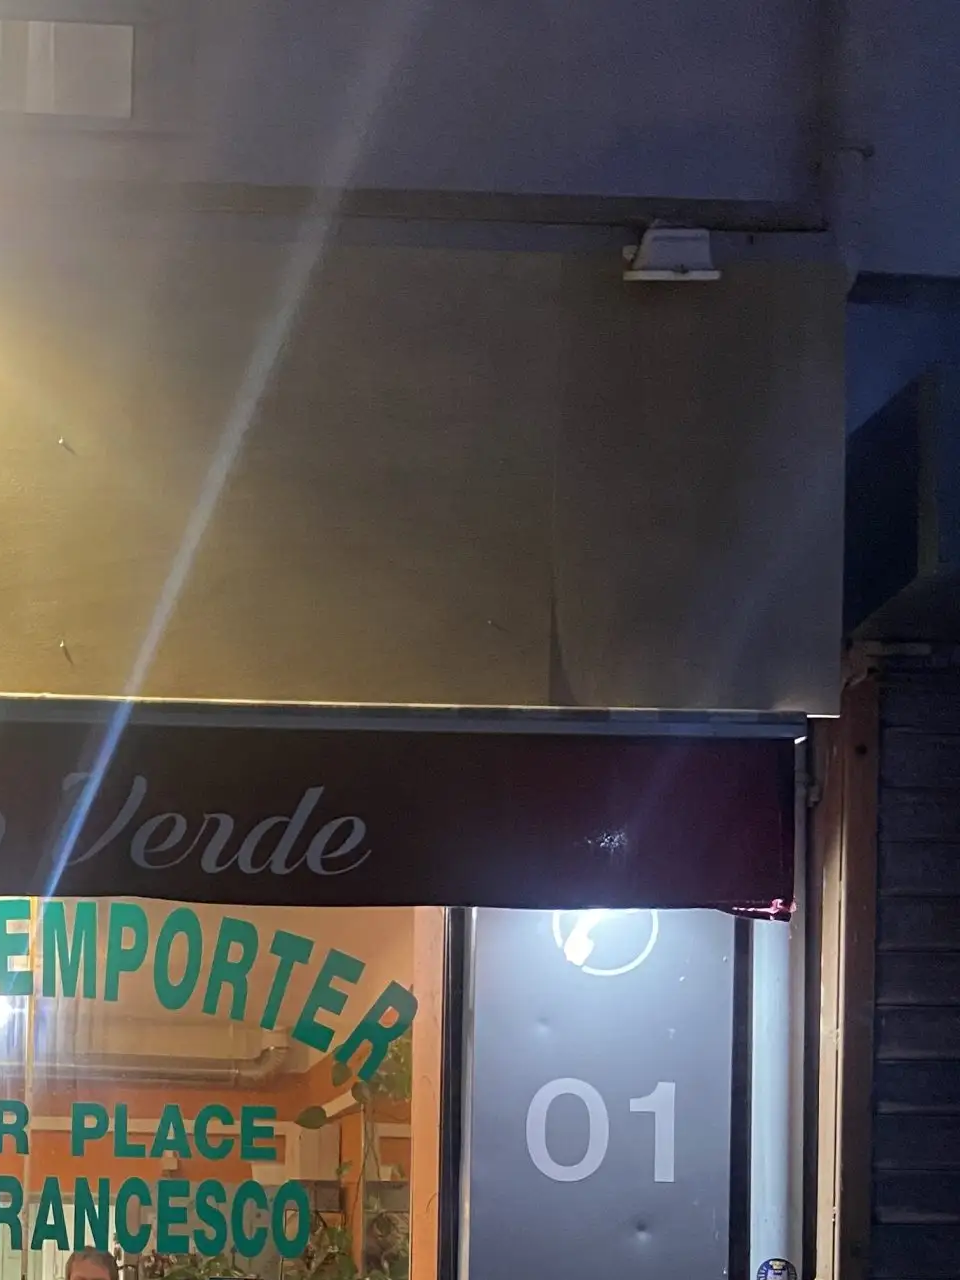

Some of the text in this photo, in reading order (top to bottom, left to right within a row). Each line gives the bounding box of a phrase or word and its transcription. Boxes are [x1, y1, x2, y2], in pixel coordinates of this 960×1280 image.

[56, 771, 372, 877] Verde
[71, 1102, 278, 1161] PLACE
[525, 1077, 676, 1183] 01
